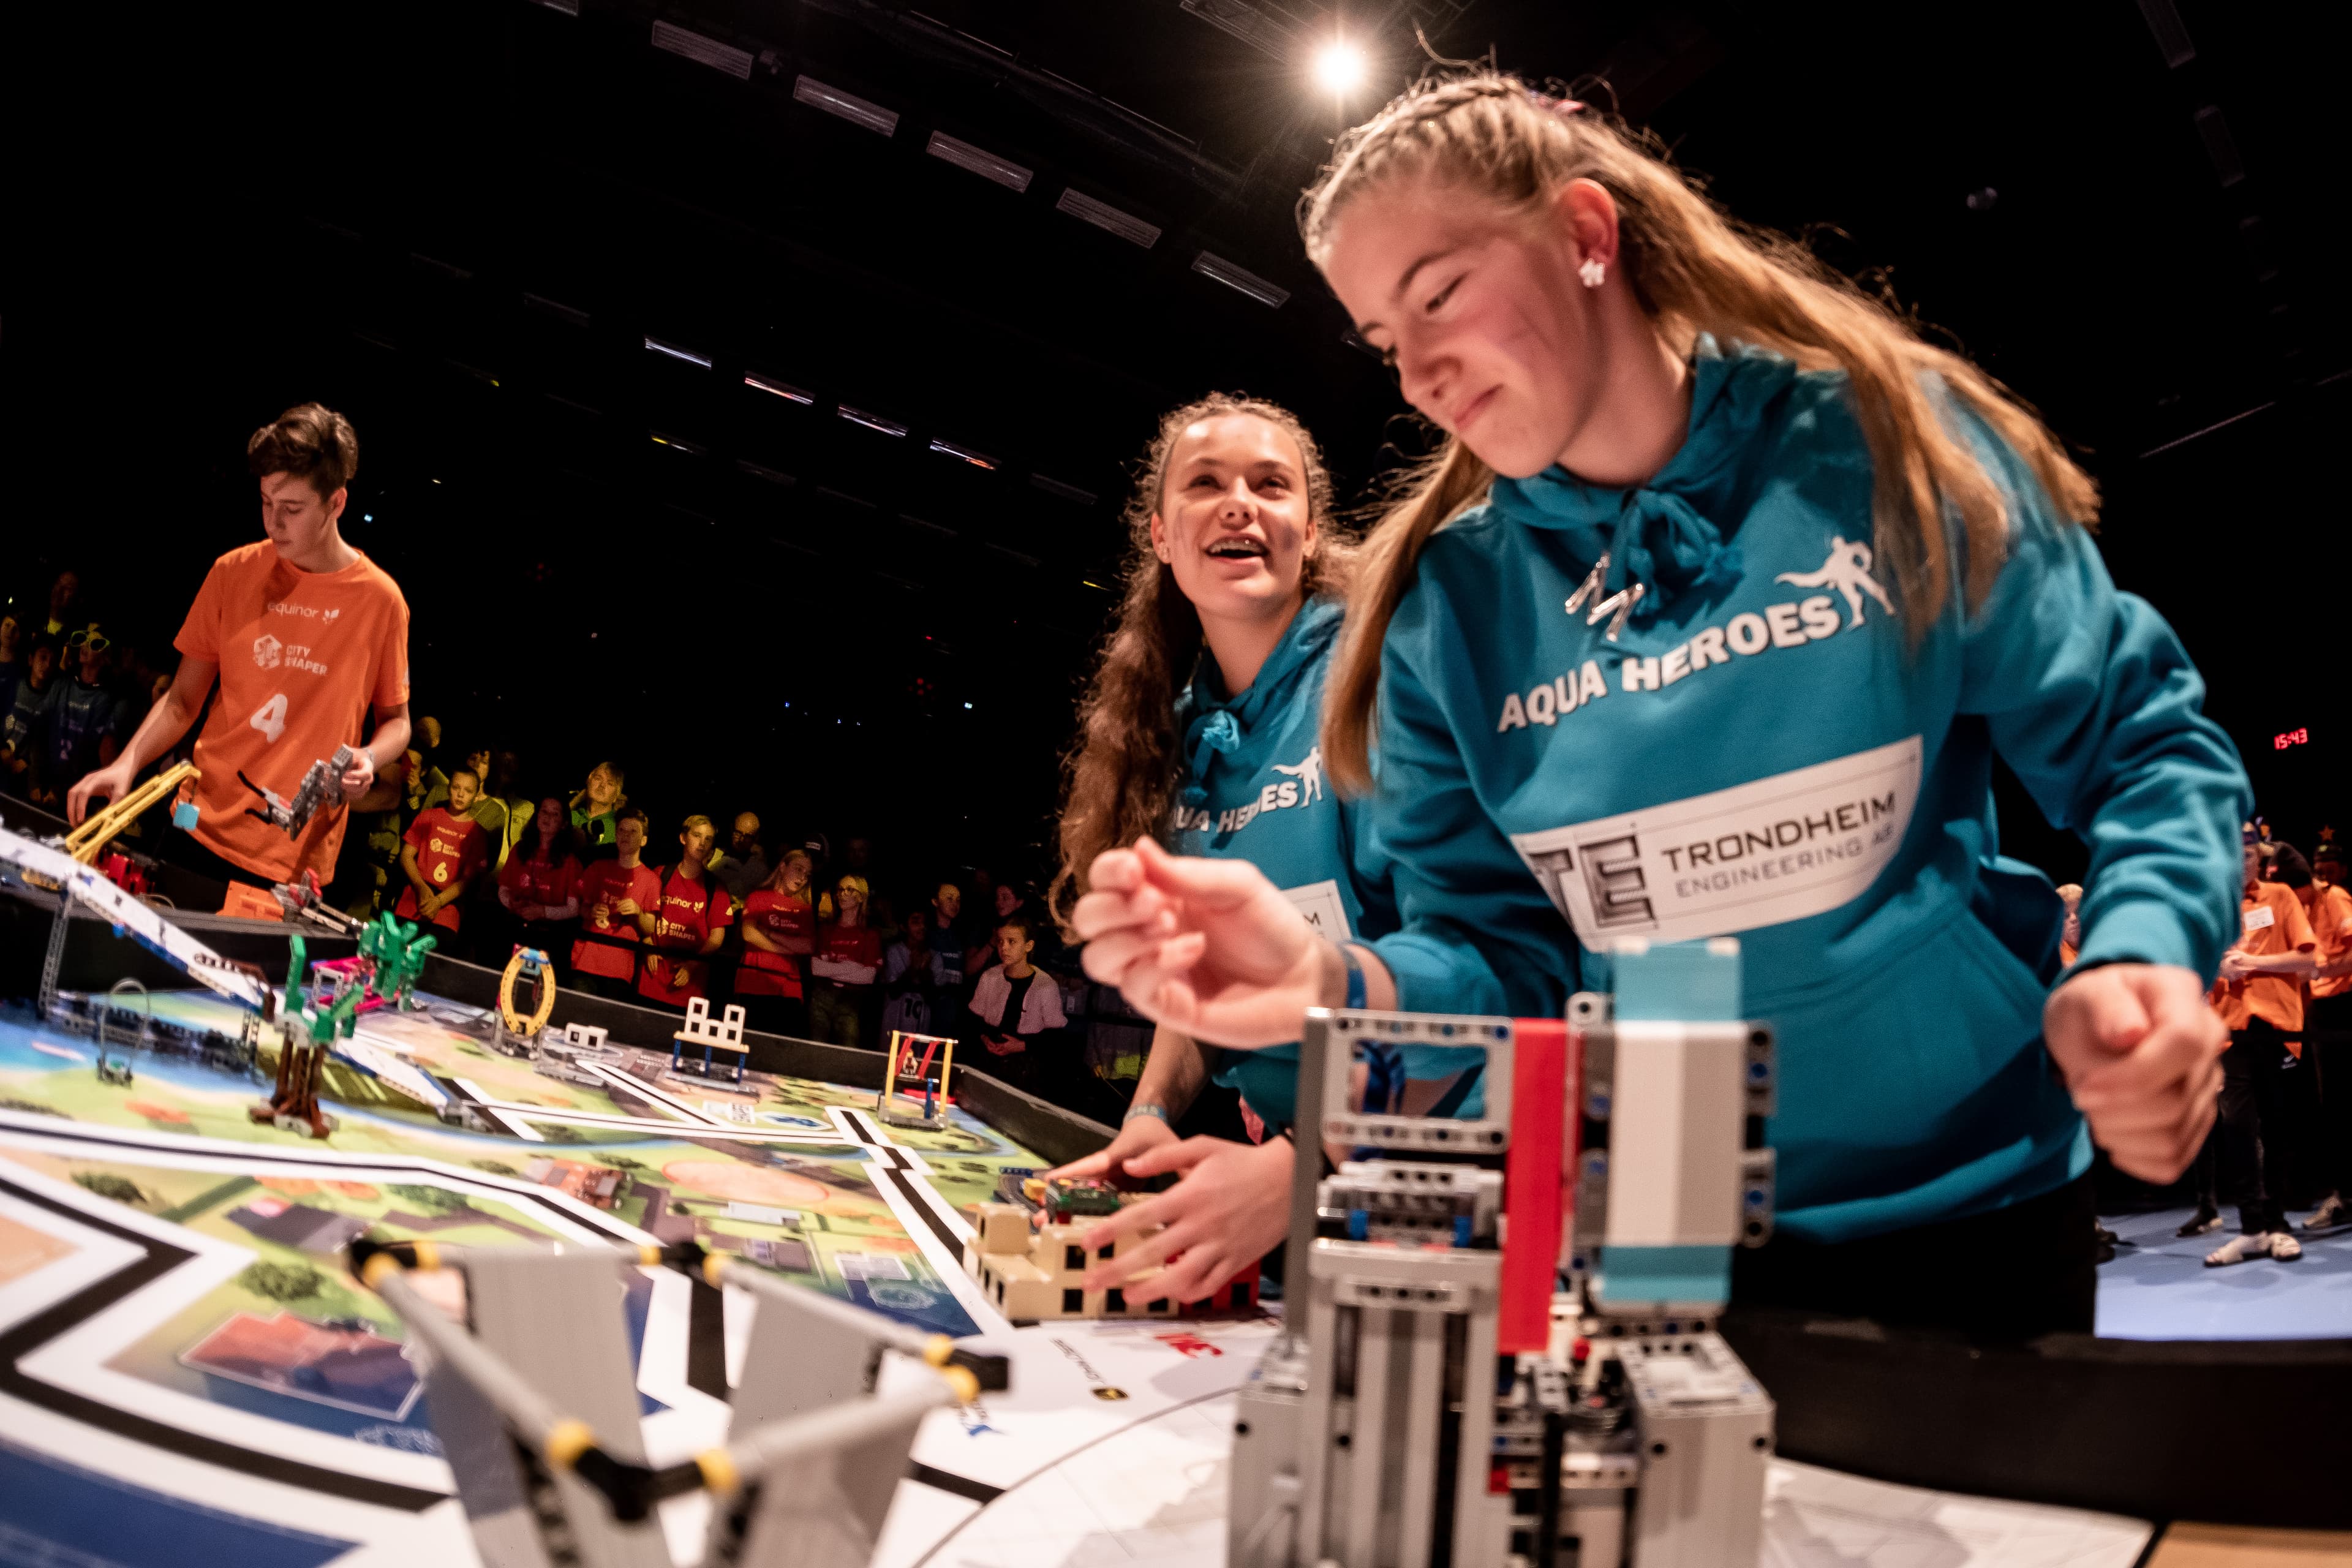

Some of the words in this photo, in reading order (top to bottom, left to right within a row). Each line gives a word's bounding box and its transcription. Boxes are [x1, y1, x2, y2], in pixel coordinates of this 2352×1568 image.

[267, 602, 319, 618] equinor
[287, 644, 311, 657] CITY
[1497, 659, 1608, 733] AQUA
[1622, 597, 1841, 693] HEROES
[249, 693, 288, 743] 4
[2274, 727, 2308, 750] 15:43
[1661, 792, 1896, 872] TRONDHEIM
[433, 862, 448, 882] 6
[1675, 837, 1864, 899] ENGINEERING
[670, 922, 686, 932] CITY
